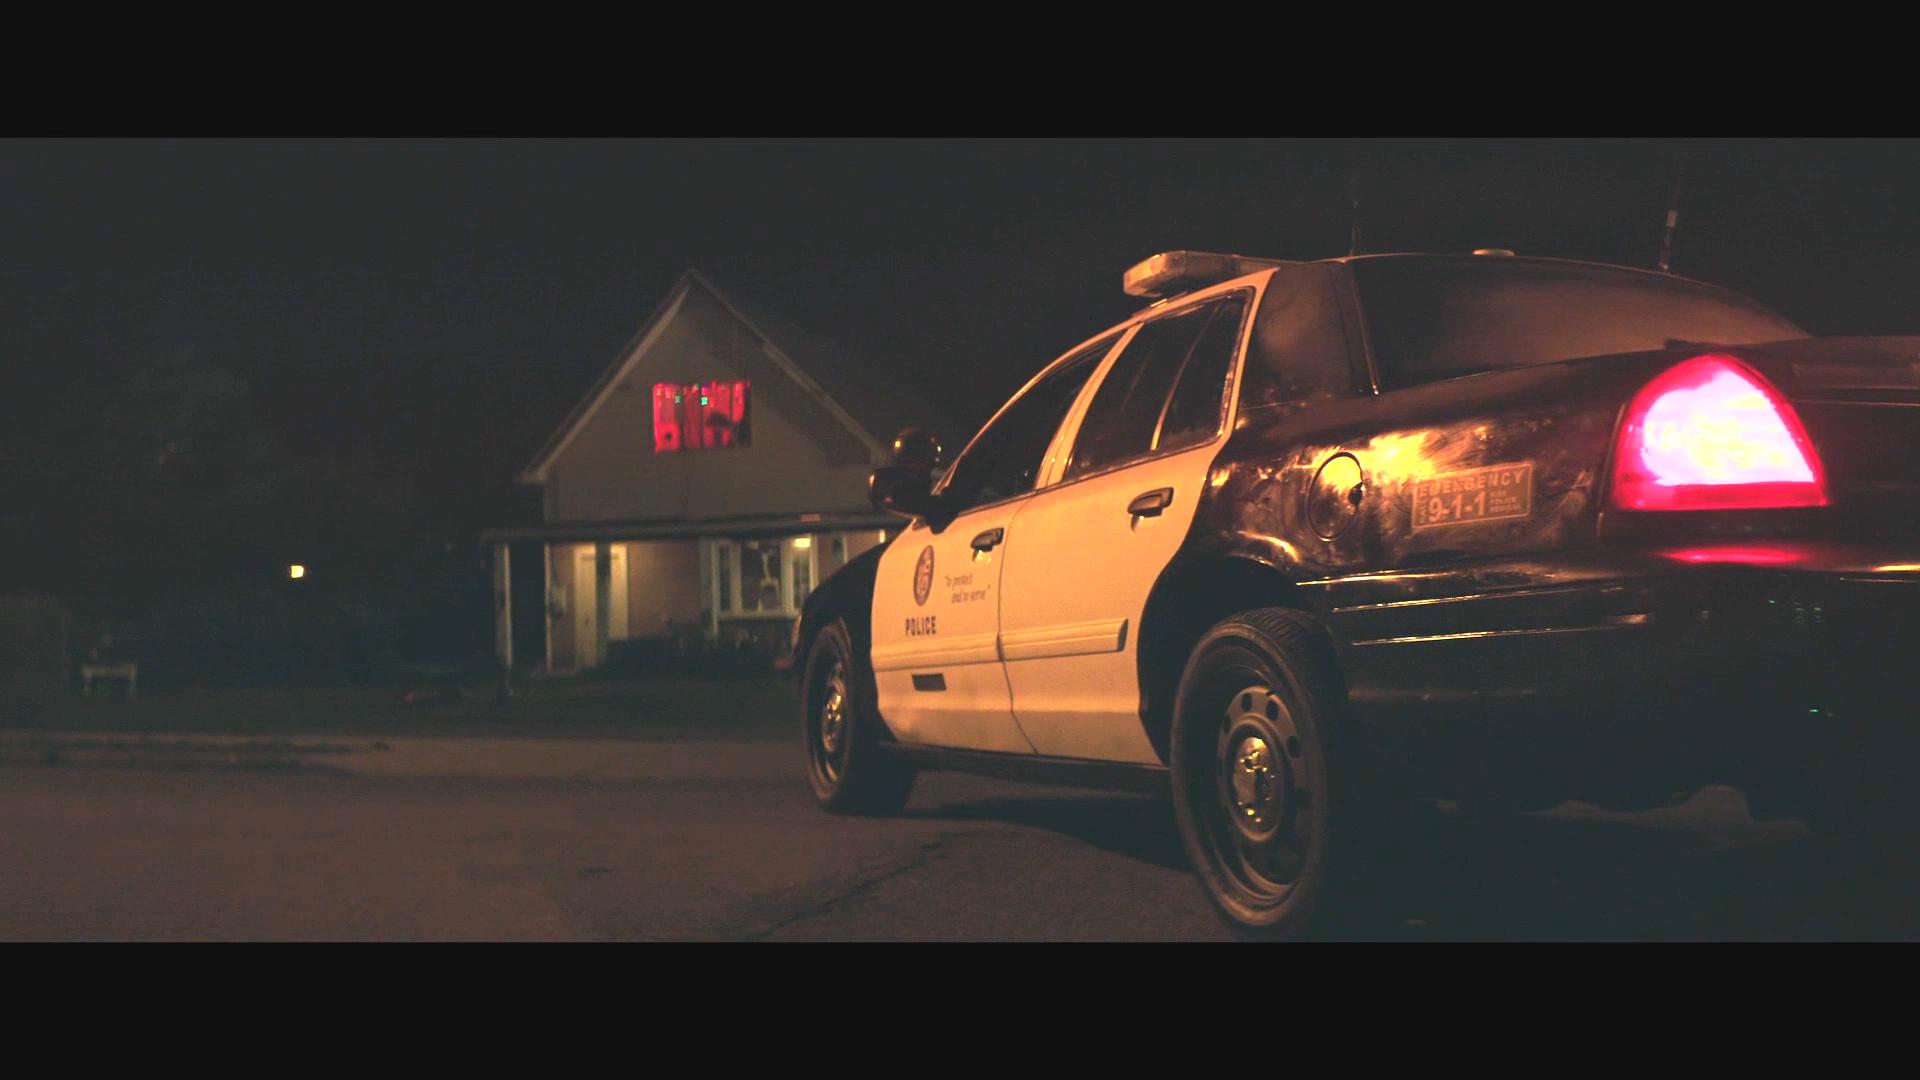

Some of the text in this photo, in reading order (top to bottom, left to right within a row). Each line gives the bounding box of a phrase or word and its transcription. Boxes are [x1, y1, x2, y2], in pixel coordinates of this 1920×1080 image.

[1419, 470, 1524, 498] EMERGENCY
[1429, 491, 1486, 522] 9-1-1
[905, 615, 937, 637] POLICE
